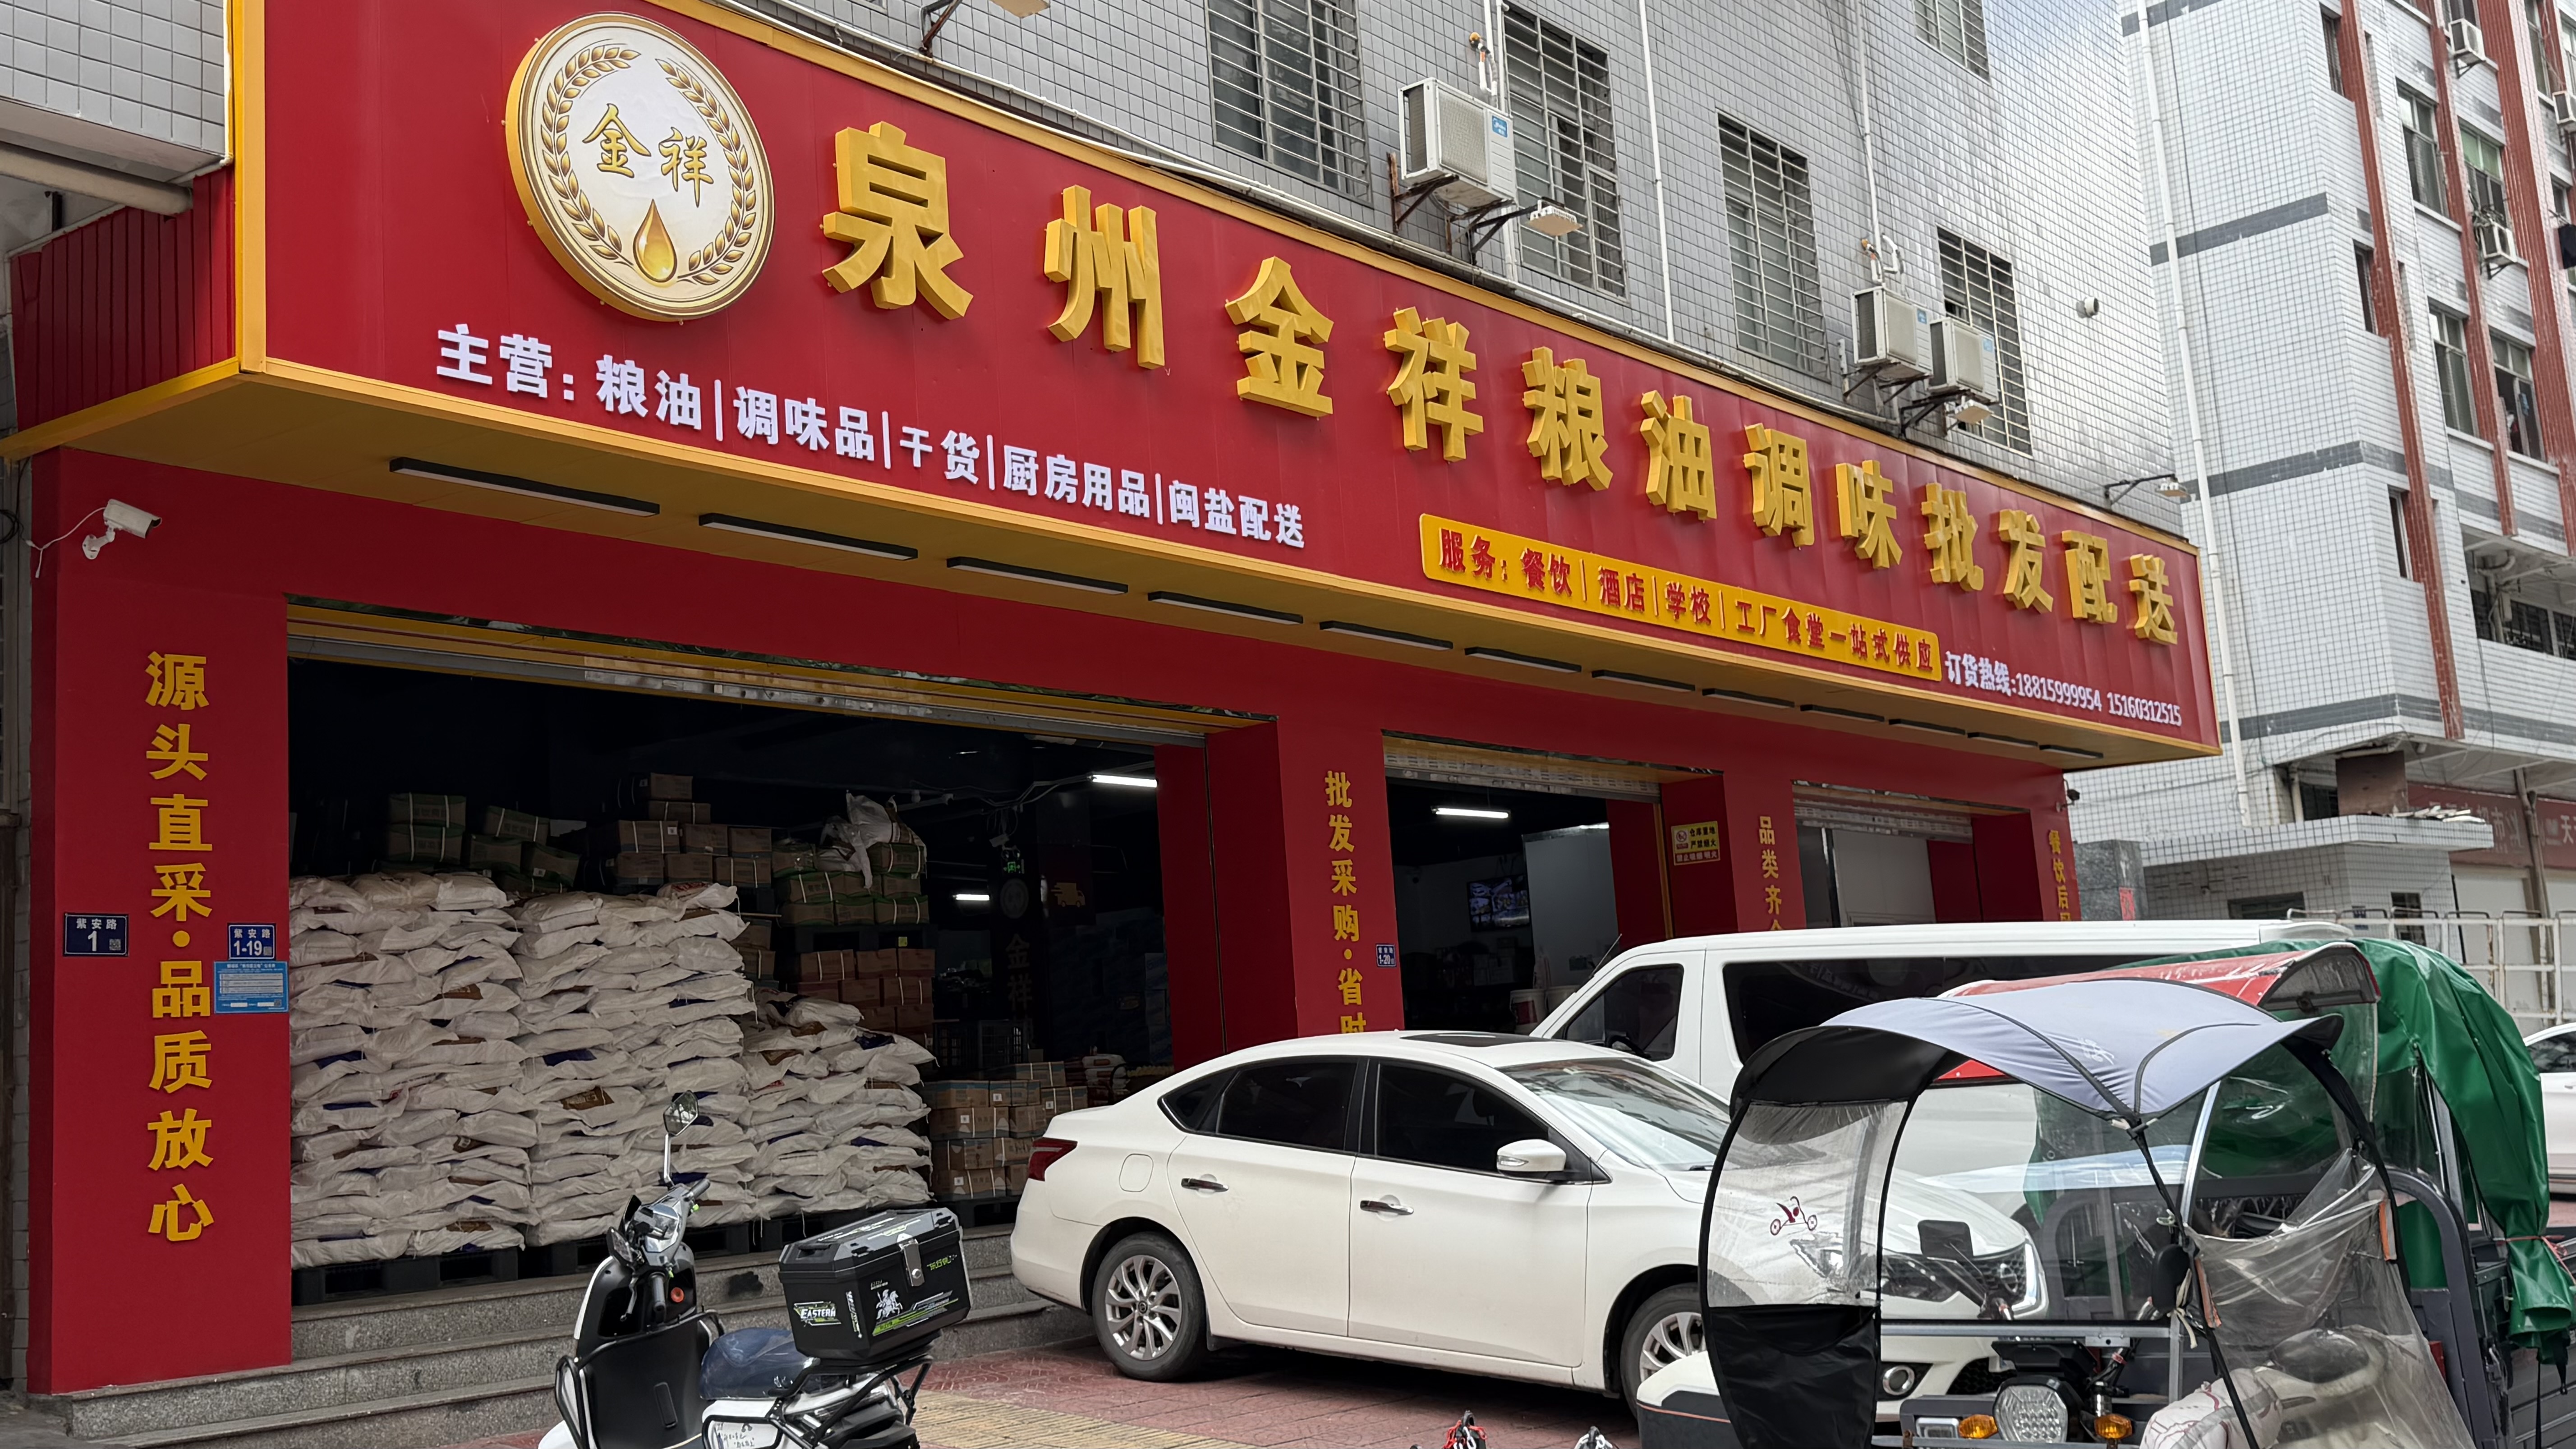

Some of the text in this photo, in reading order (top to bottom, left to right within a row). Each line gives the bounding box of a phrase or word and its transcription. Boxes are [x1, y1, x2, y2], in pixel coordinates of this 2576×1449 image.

[582, 103, 714, 207] 金祥
[821, 121, 2178, 645] 泉州金祥粮油调味批发配送
[2107, 692, 2182, 726] 15160312515
[87, 930, 97, 952] 1
[234, 940, 262, 956] 1-19
